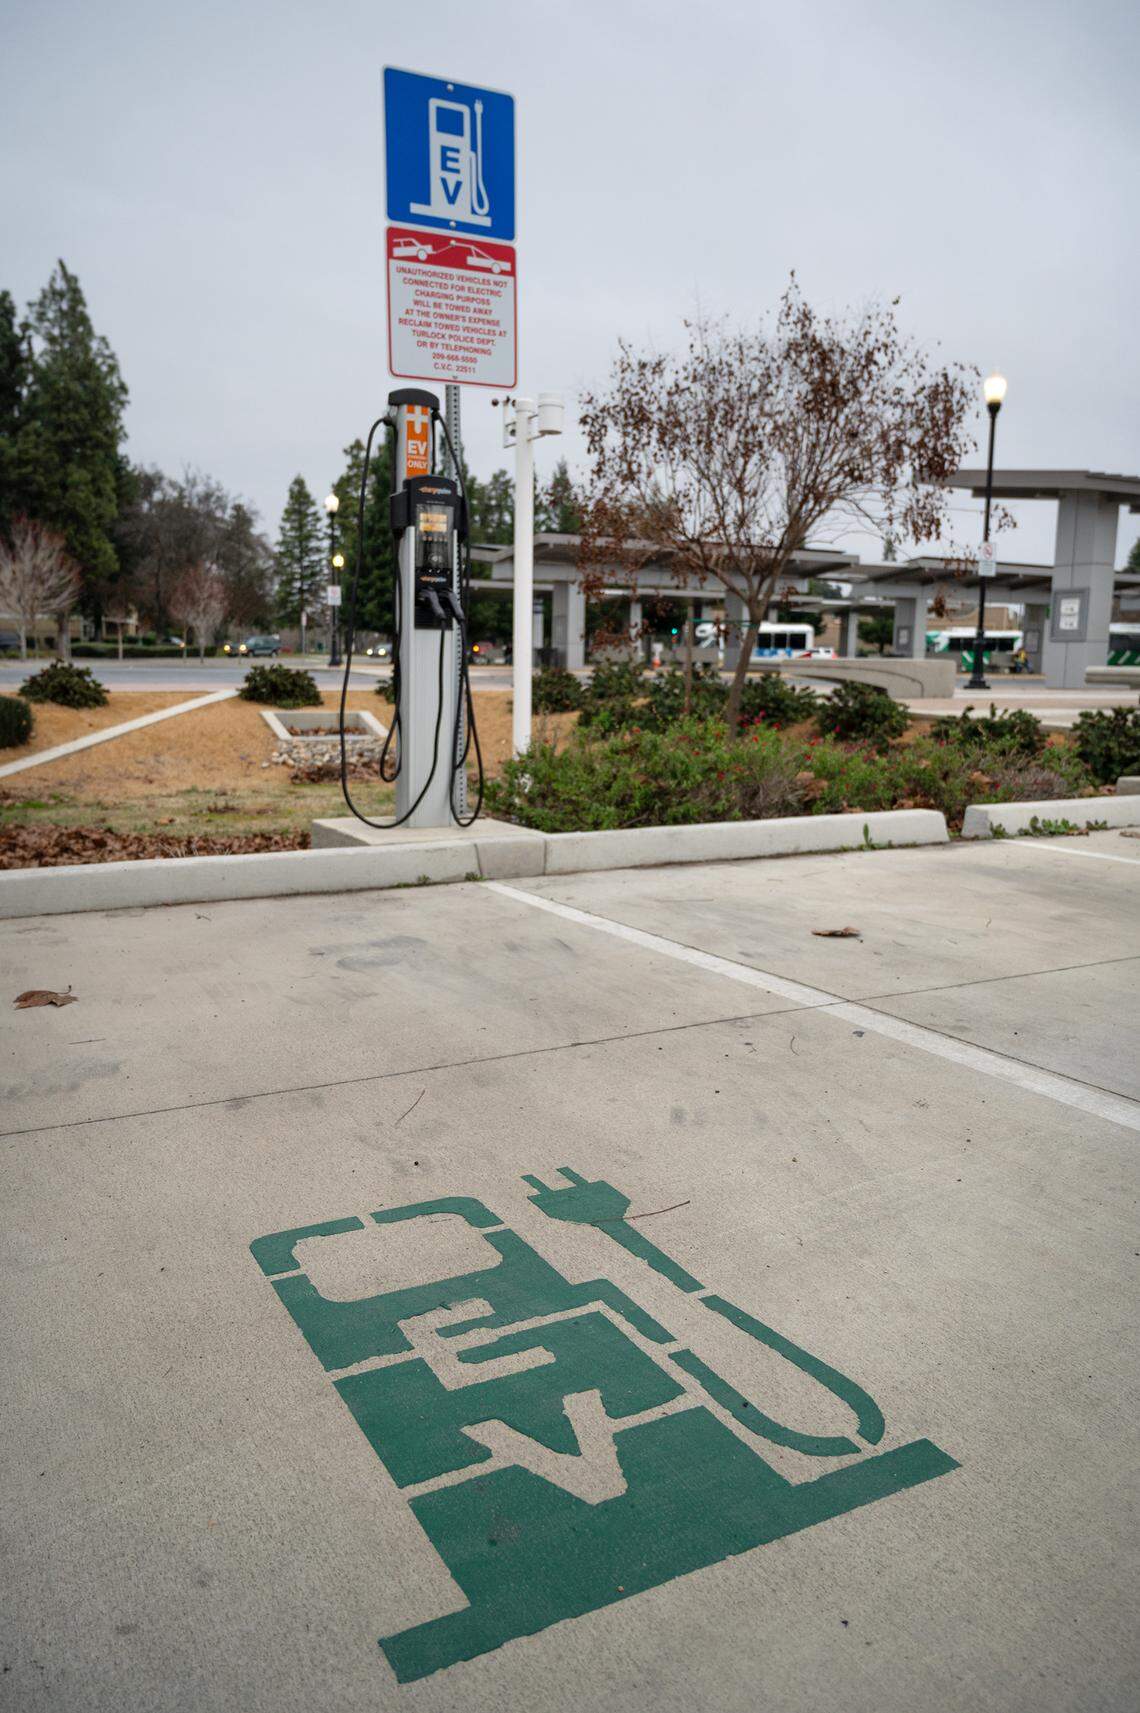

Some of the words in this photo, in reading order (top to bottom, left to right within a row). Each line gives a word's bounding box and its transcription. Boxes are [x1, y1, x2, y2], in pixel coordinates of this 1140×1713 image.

[440, 145, 463, 205] EV
[396, 266, 454, 280] UNAUTHORIZED
[457, 275, 491, 286] VEHICLES
[493, 280, 507, 288] NOT
[403, 276, 449, 290] CONNECTED
[451, 283, 465, 292] FOR
[467, 286, 503, 297] ELECTRIC
[415, 289, 455, 301] CHARGING
[413, 299, 431, 308] WILL
[445, 303, 471, 313] TOWED
[473, 307, 492, 315] AWAY
[416, 309, 431, 318] THE
[433, 312, 466, 322] OWNER'S
[468, 316, 500, 327] EXPENSE
[399, 317, 432, 327] RECLAIM
[434, 321, 461, 332] TOWED
[462, 327, 497, 337] VEHICLES
[498, 330, 507, 338] AT
[412, 330, 446, 340] TURLOCK
[448, 334, 475, 344] POLICE
[417, 340, 428, 348] OR
[442, 343, 492, 356] TELEPHONING
[408, 440, 427, 455] EV
[397, 1297, 628, 1506] EV
